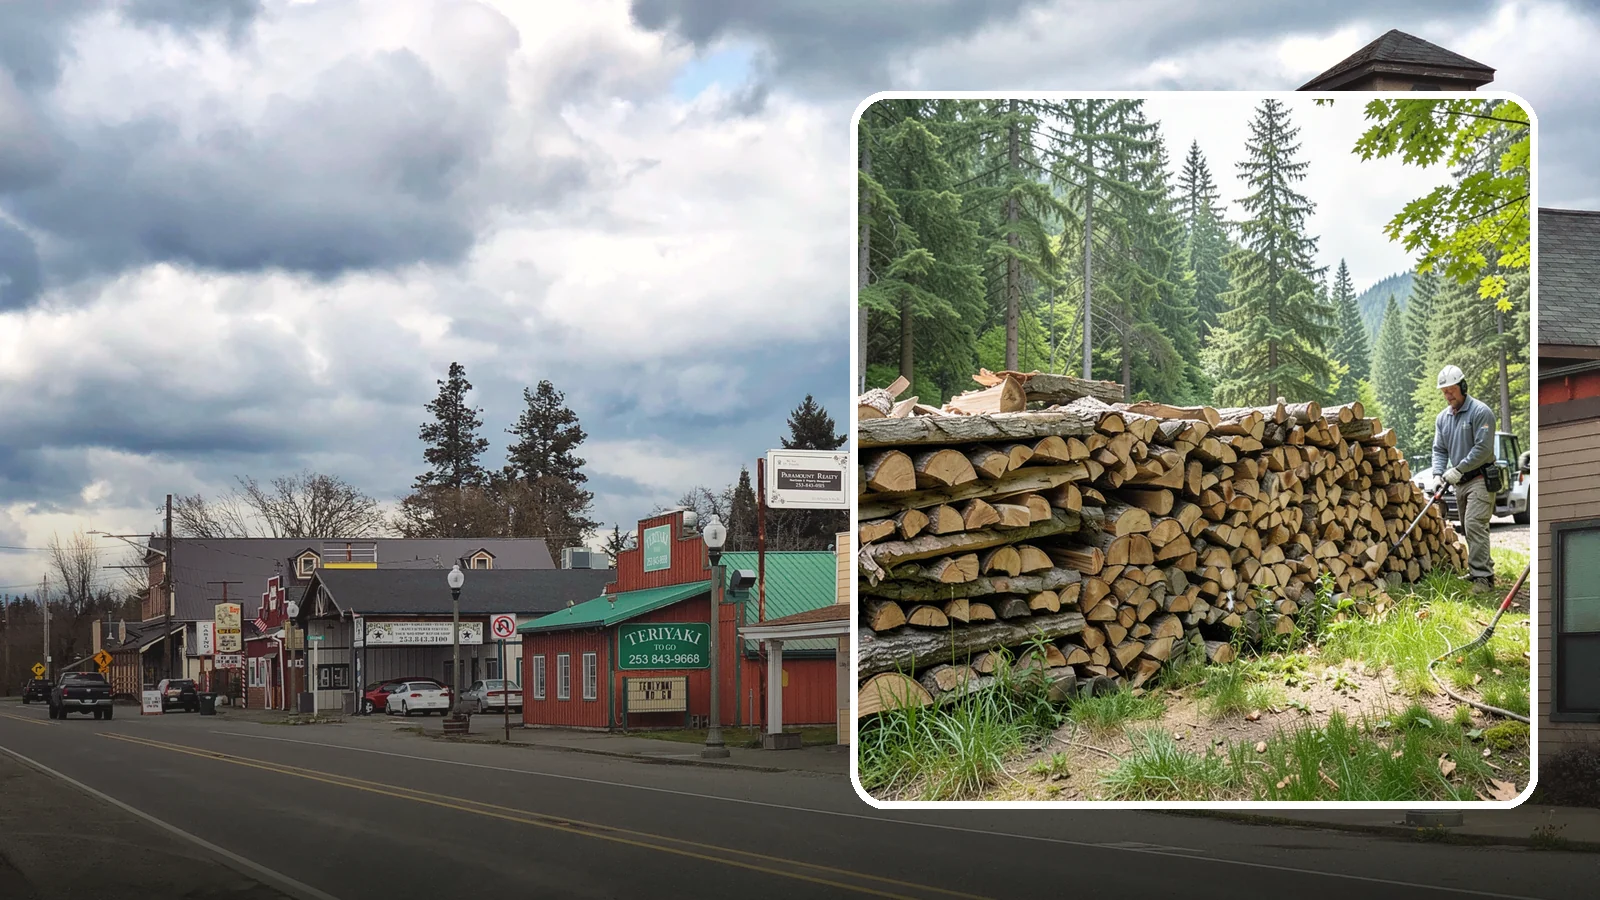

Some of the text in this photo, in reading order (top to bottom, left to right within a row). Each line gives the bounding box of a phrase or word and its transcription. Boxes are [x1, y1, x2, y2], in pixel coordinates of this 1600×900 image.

[646, 531, 668, 549] TERIYAKI
[625, 627, 702, 646] TERIYAKI
[629, 653, 700, 665] 253 843-9668
[639, 681, 672, 691] TERIYAKI
